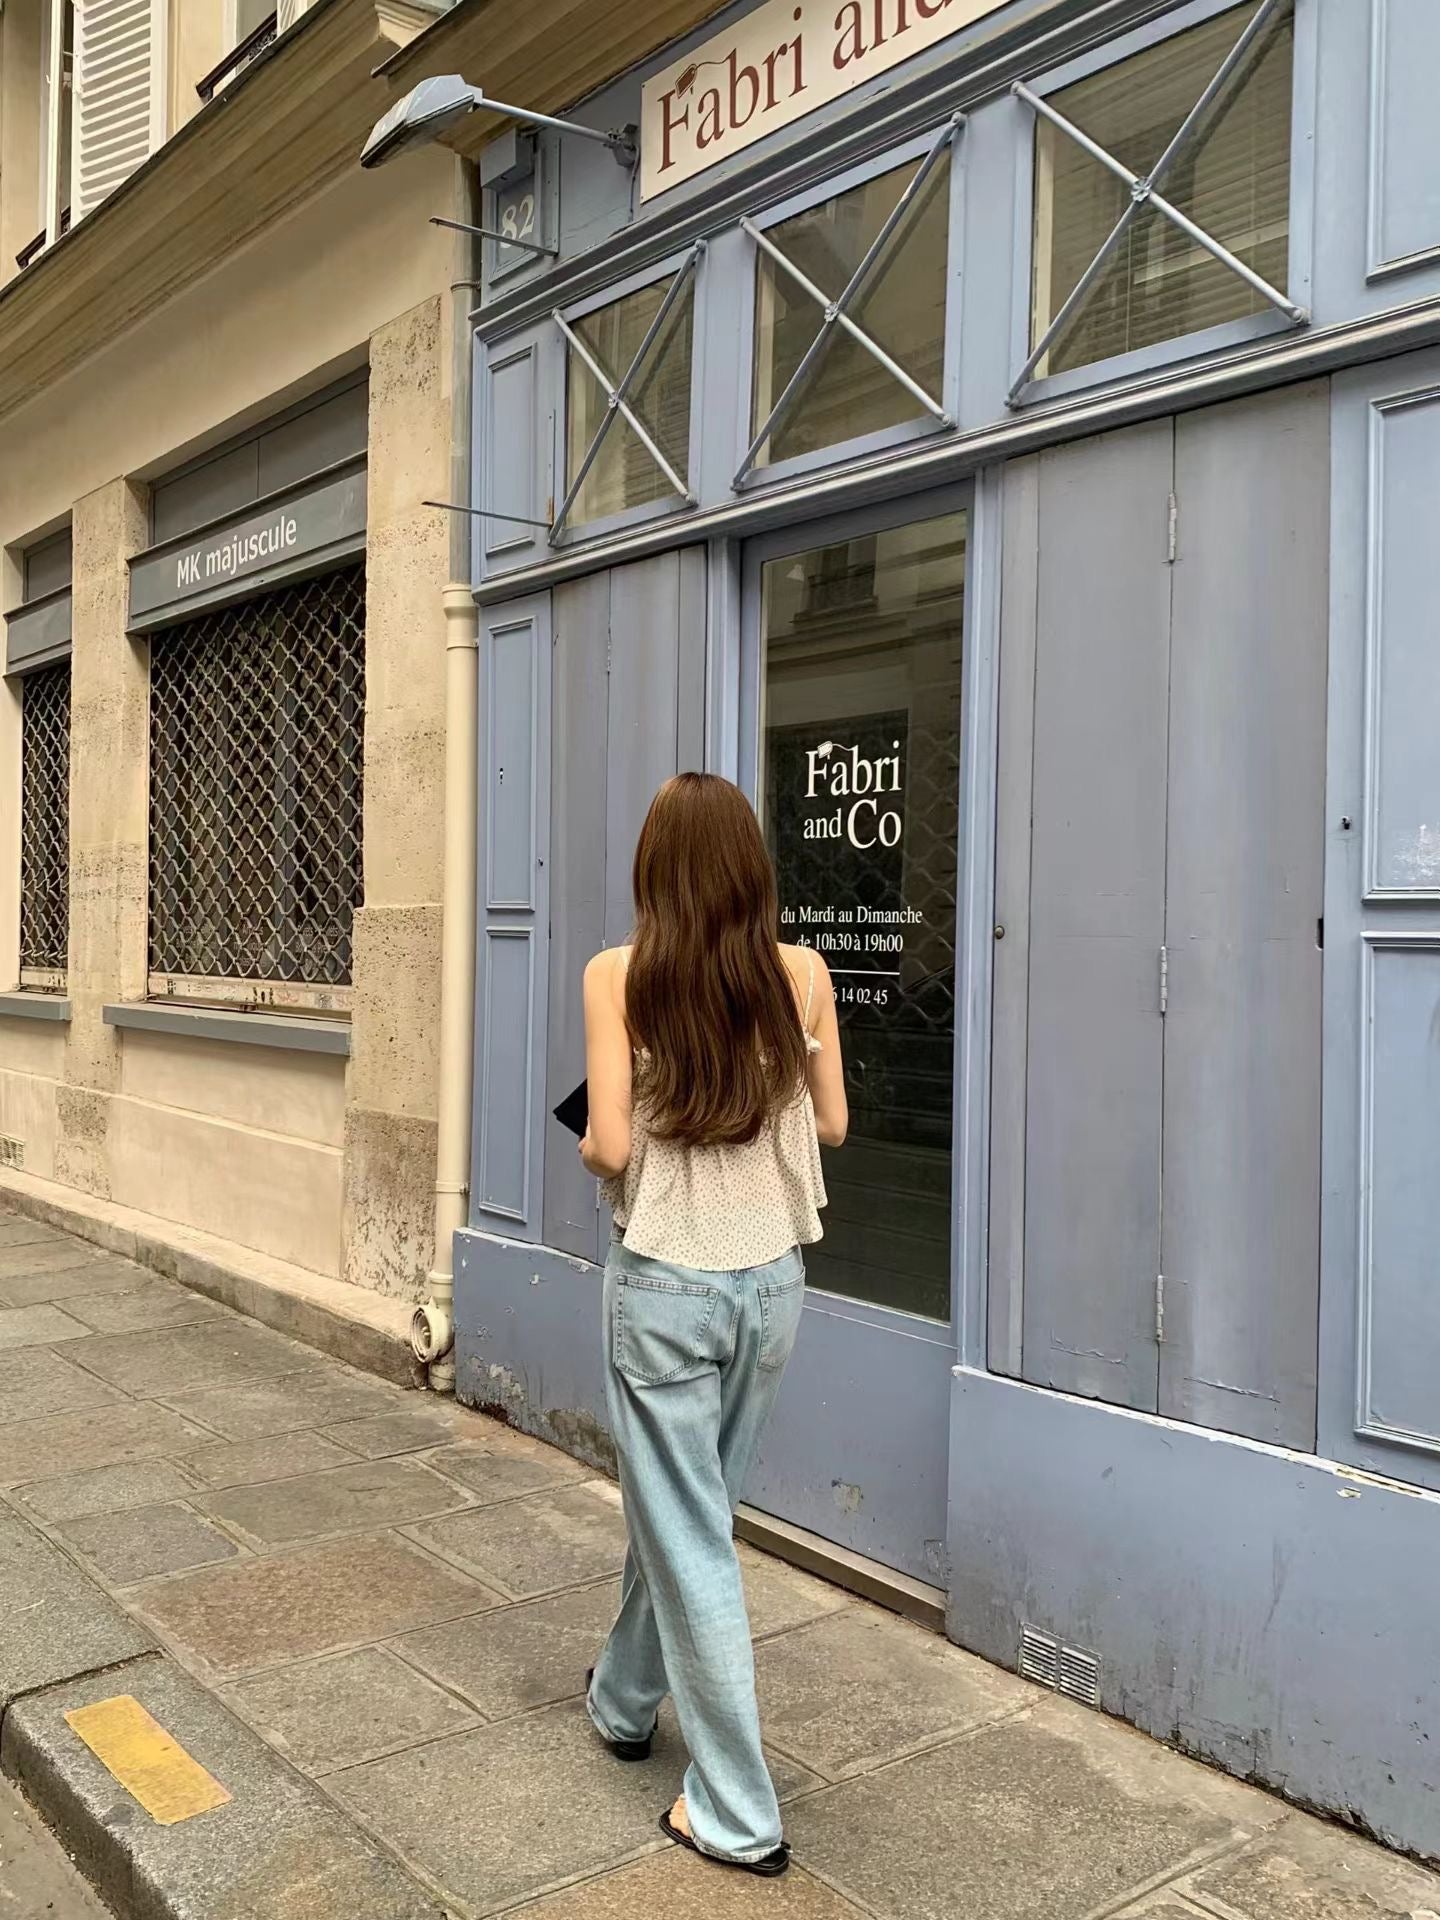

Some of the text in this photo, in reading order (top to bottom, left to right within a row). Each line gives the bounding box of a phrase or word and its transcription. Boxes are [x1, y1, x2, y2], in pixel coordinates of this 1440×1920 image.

[656, 0, 953, 174] Fabri an
[502, 194, 535, 249] 82
[177, 515, 297, 588] MK majuscule
[803, 739, 902, 798] Fabri
[803, 798, 901, 849] and Co
[780, 905, 923, 924] du Mardi au Dimanche
[797, 933, 904, 952] de 10h30 à 19h00
[841, 987, 854, 1003] 14
[856, 987, 871, 1004] 02
[873, 989, 888, 1005] 45
